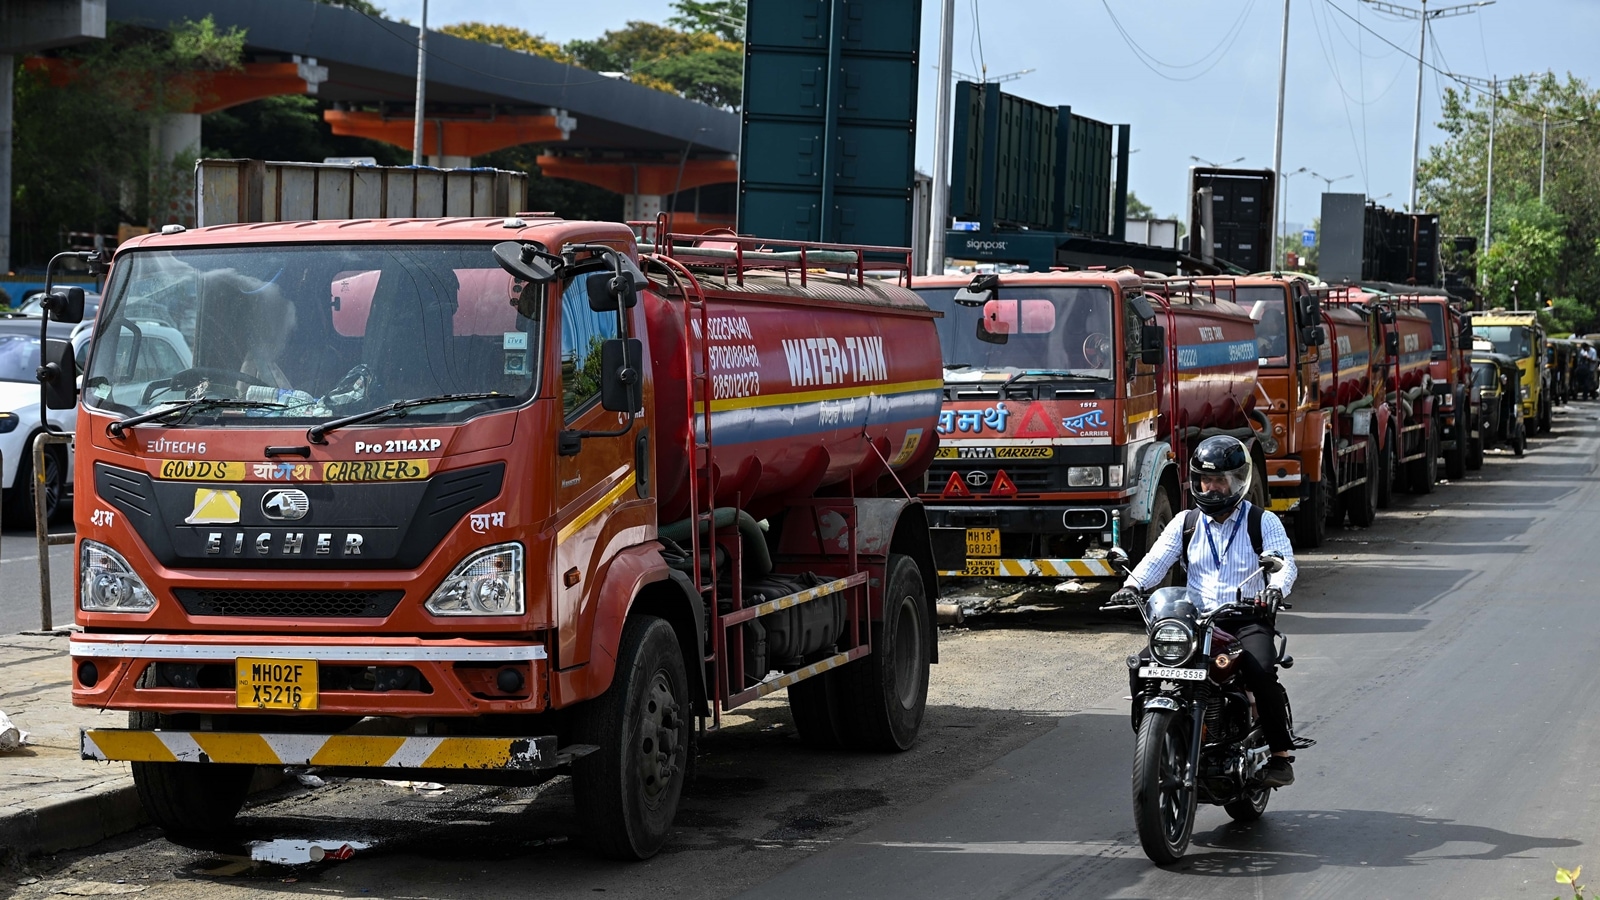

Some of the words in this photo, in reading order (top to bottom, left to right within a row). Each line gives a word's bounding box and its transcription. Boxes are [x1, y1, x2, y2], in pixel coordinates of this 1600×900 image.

[966, 238, 1006, 250] signpost
[781, 337, 843, 387] WATER
[845, 336, 888, 383] TANK
[713, 371, 760, 400] 8850121273
[355, 441, 382, 453] Pro
[385, 439, 441, 453] 2114XP
[959, 447, 995, 458] TATA
[997, 447, 1049, 458] CARRIER
[163, 461, 227, 479] GOODS
[470, 511, 506, 534] लाभ
[206, 532, 364, 554] EICHER
[967, 531, 992, 541] MH18
[966, 543, 998, 554] G8231
[252, 663, 303, 683] MH02F
[252, 685, 302, 704] X5216
